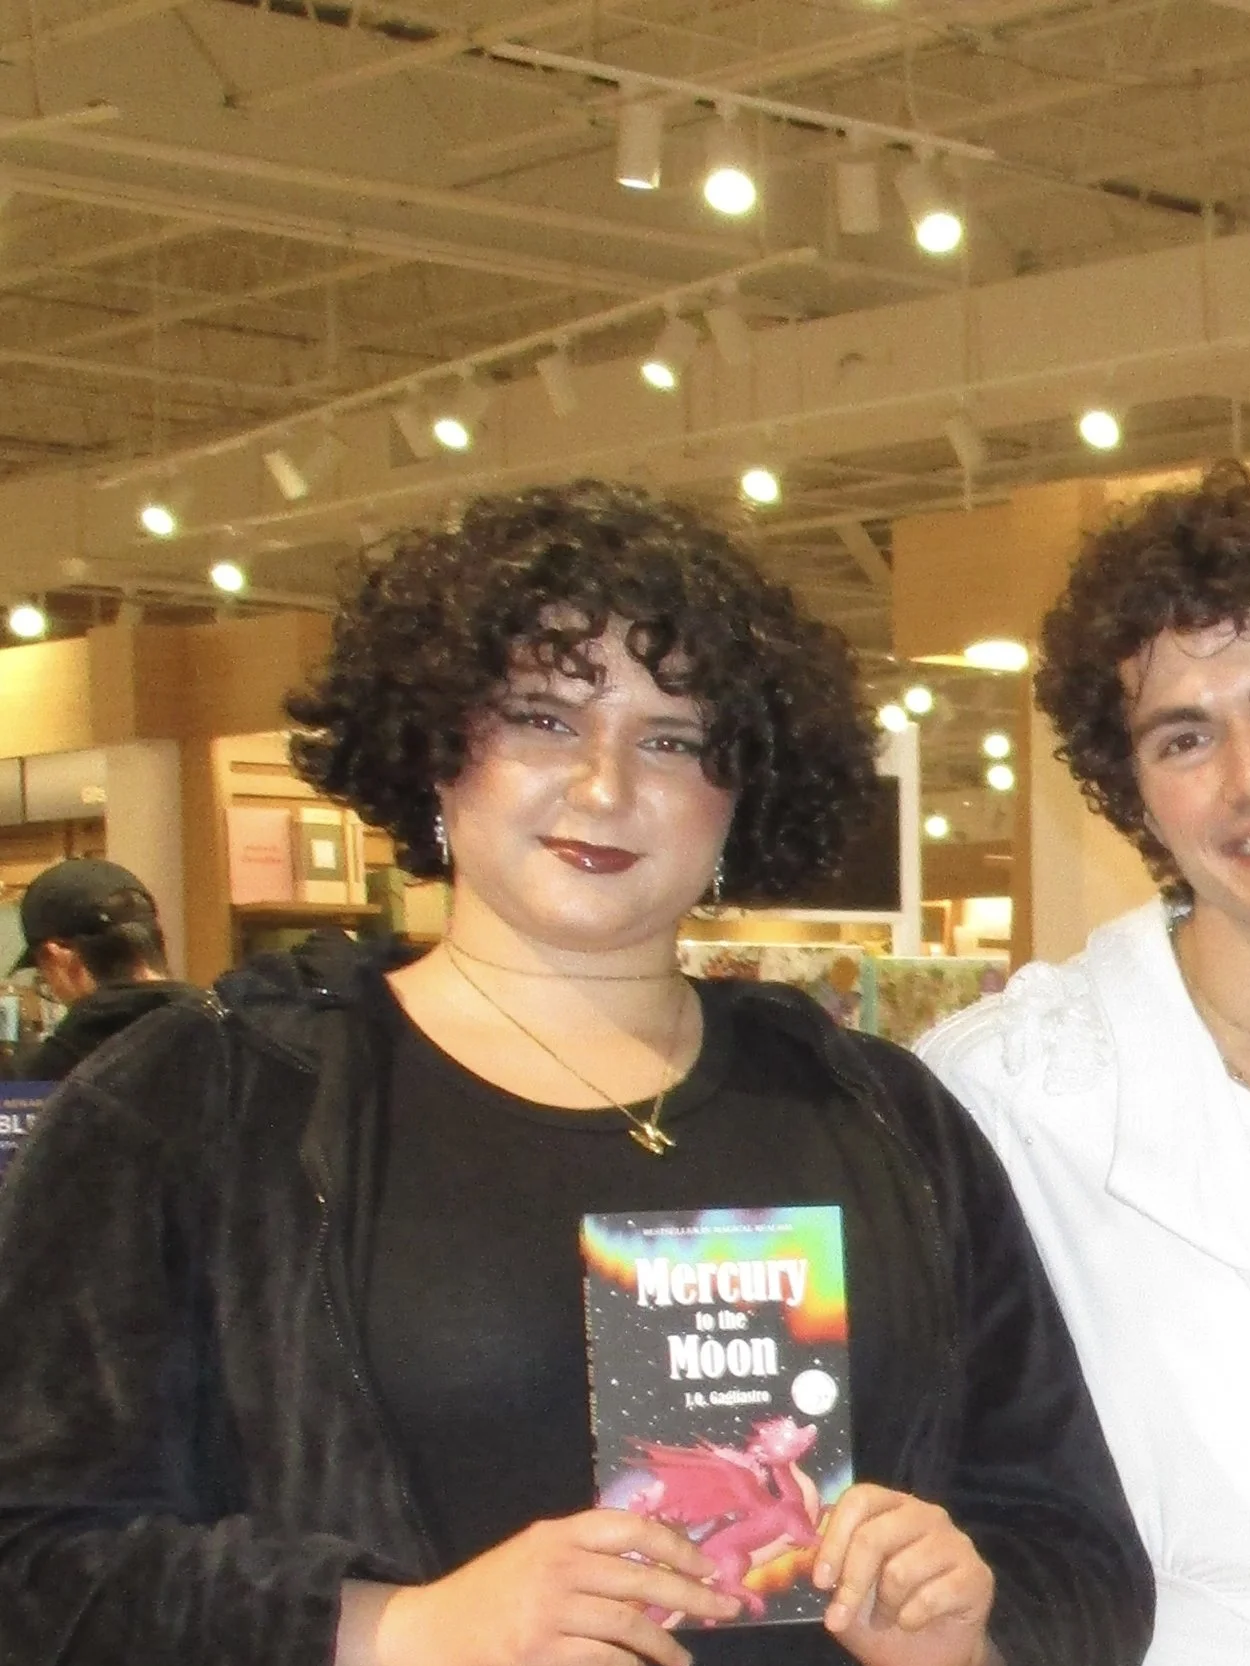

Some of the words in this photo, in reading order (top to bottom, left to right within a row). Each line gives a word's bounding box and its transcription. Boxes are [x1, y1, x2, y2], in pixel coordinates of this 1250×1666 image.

[634, 1257, 808, 1307] Mercury
[695, 1311, 715, 1332] to
[718, 1310, 749, 1331] the
[667, 1334, 779, 1380] Moon
